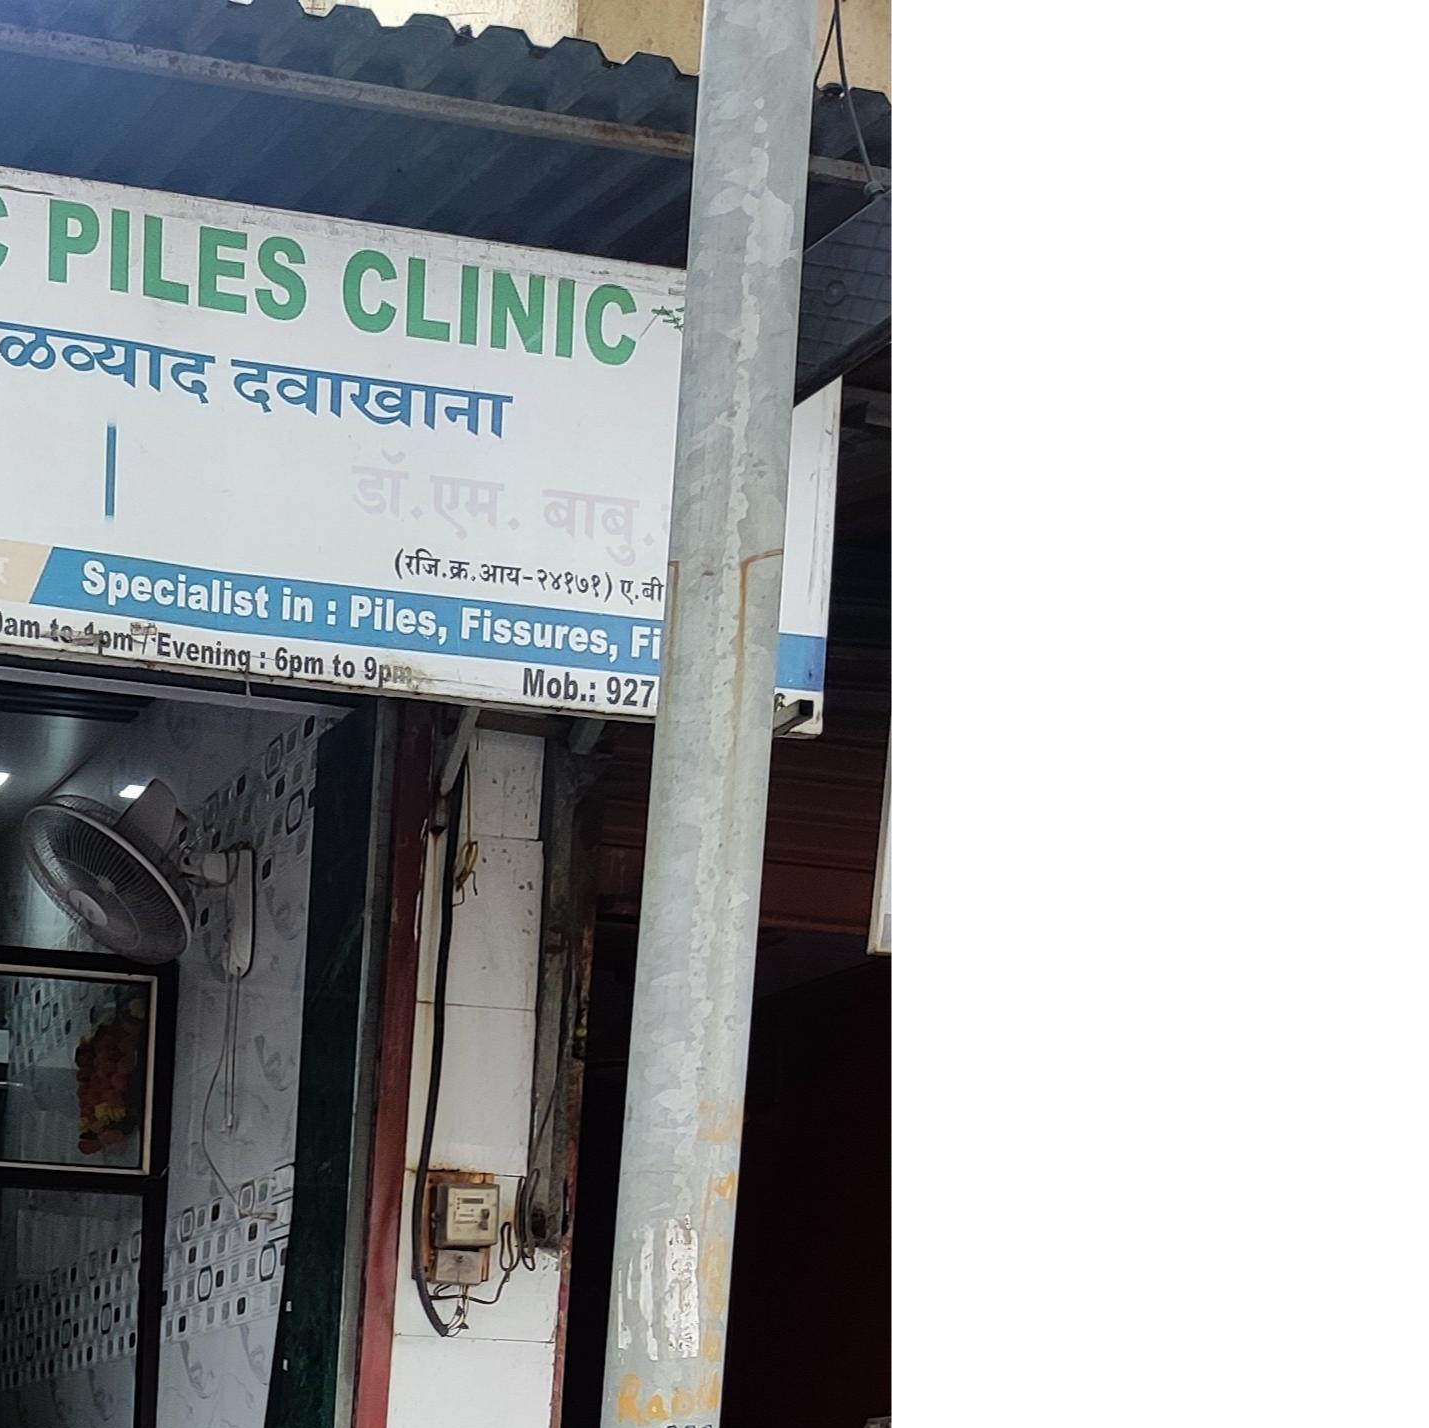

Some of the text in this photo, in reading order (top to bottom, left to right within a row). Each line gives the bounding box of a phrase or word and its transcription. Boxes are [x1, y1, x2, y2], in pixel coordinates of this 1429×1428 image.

[47, 199, 306, 320] PILES
[342, 249, 636, 366] CLINIC
[232, 358, 513, 438] दवाखाना
[50, 618, 72, 643] to
[157, 632, 250, 671] Evening
[275, 646, 324, 678] 6pm
[333, 654, 355, 677] to
[82, 560, 269, 619] Specialist
[282, 588, 314, 622] in
[350, 595, 448, 645] Piles,
[461, 607, 618, 663] Fissures,
[523, 667, 655, 708] Mob.: 927
